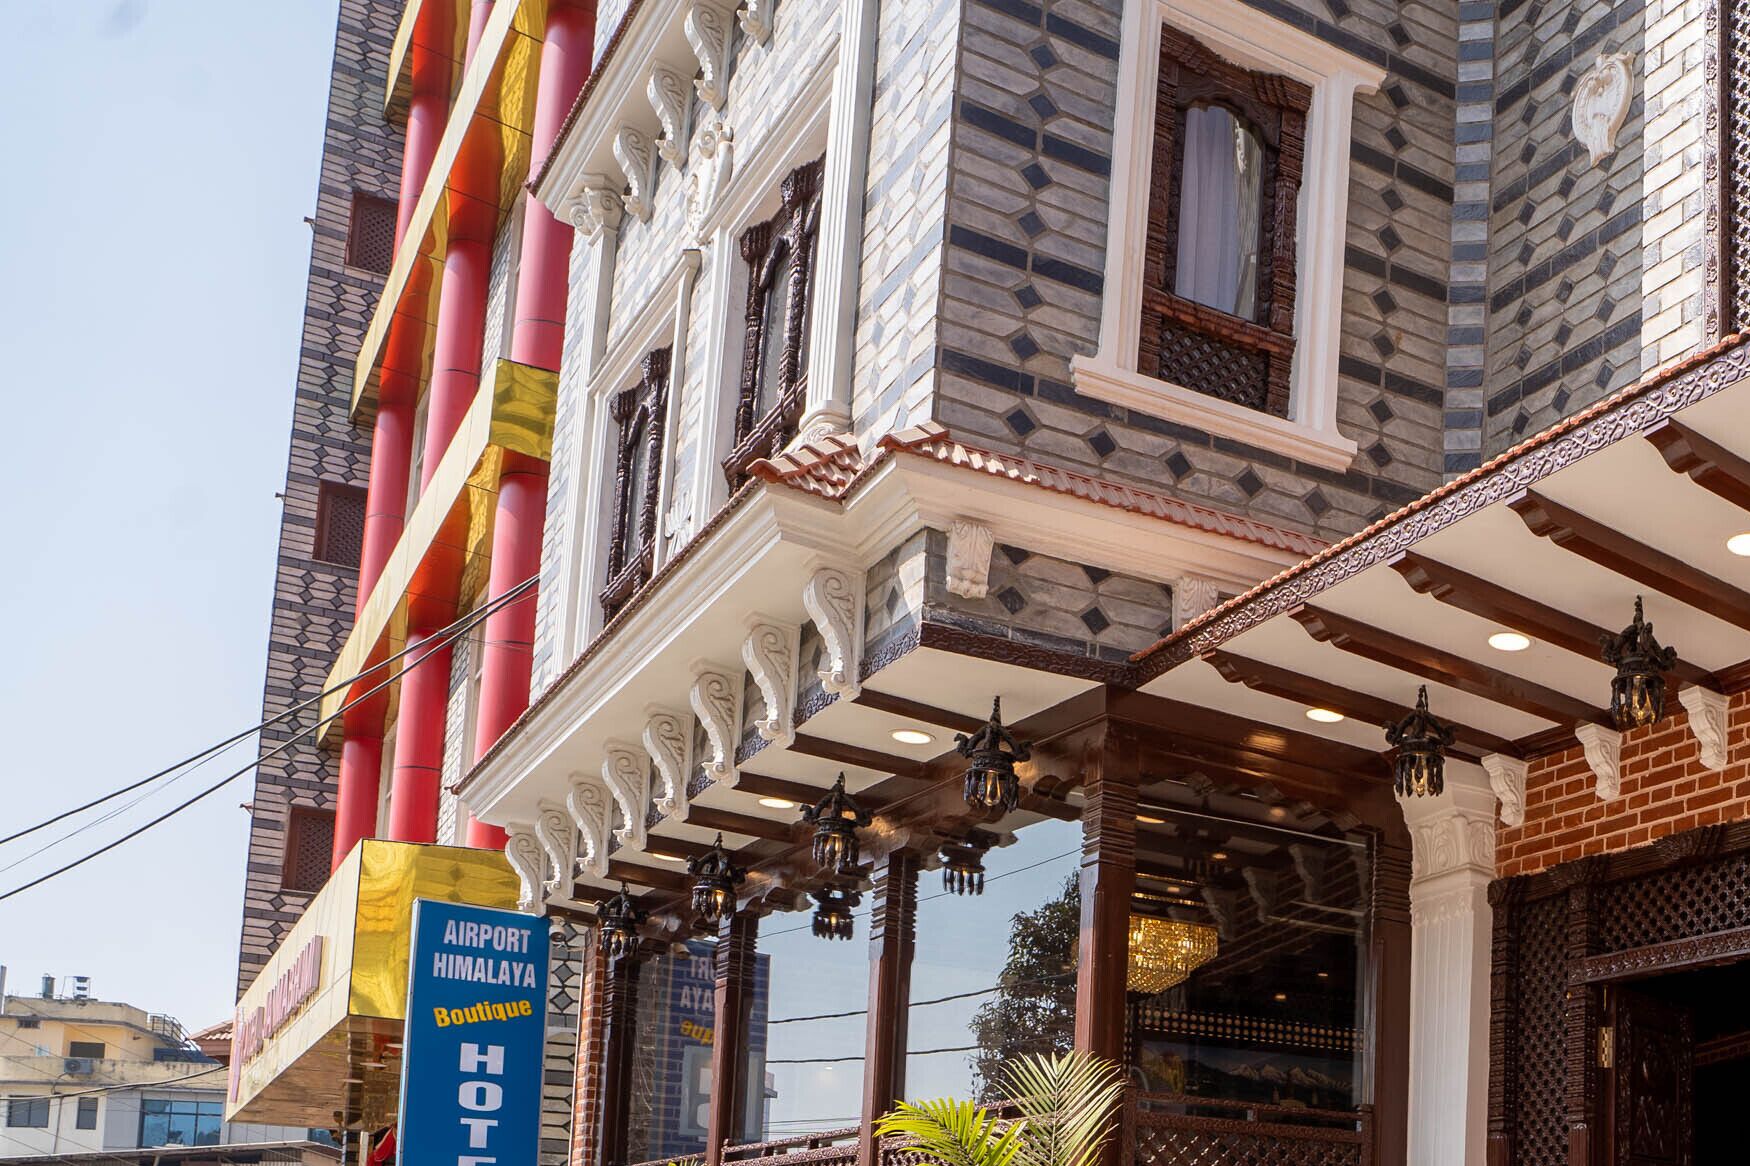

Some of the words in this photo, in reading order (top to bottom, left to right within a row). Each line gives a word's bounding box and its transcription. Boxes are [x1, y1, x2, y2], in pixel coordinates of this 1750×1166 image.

[444, 919, 531, 954] AIRPORT
[433, 953, 536, 988] HIMALAYA
[433, 999, 532, 1028] Boutique
